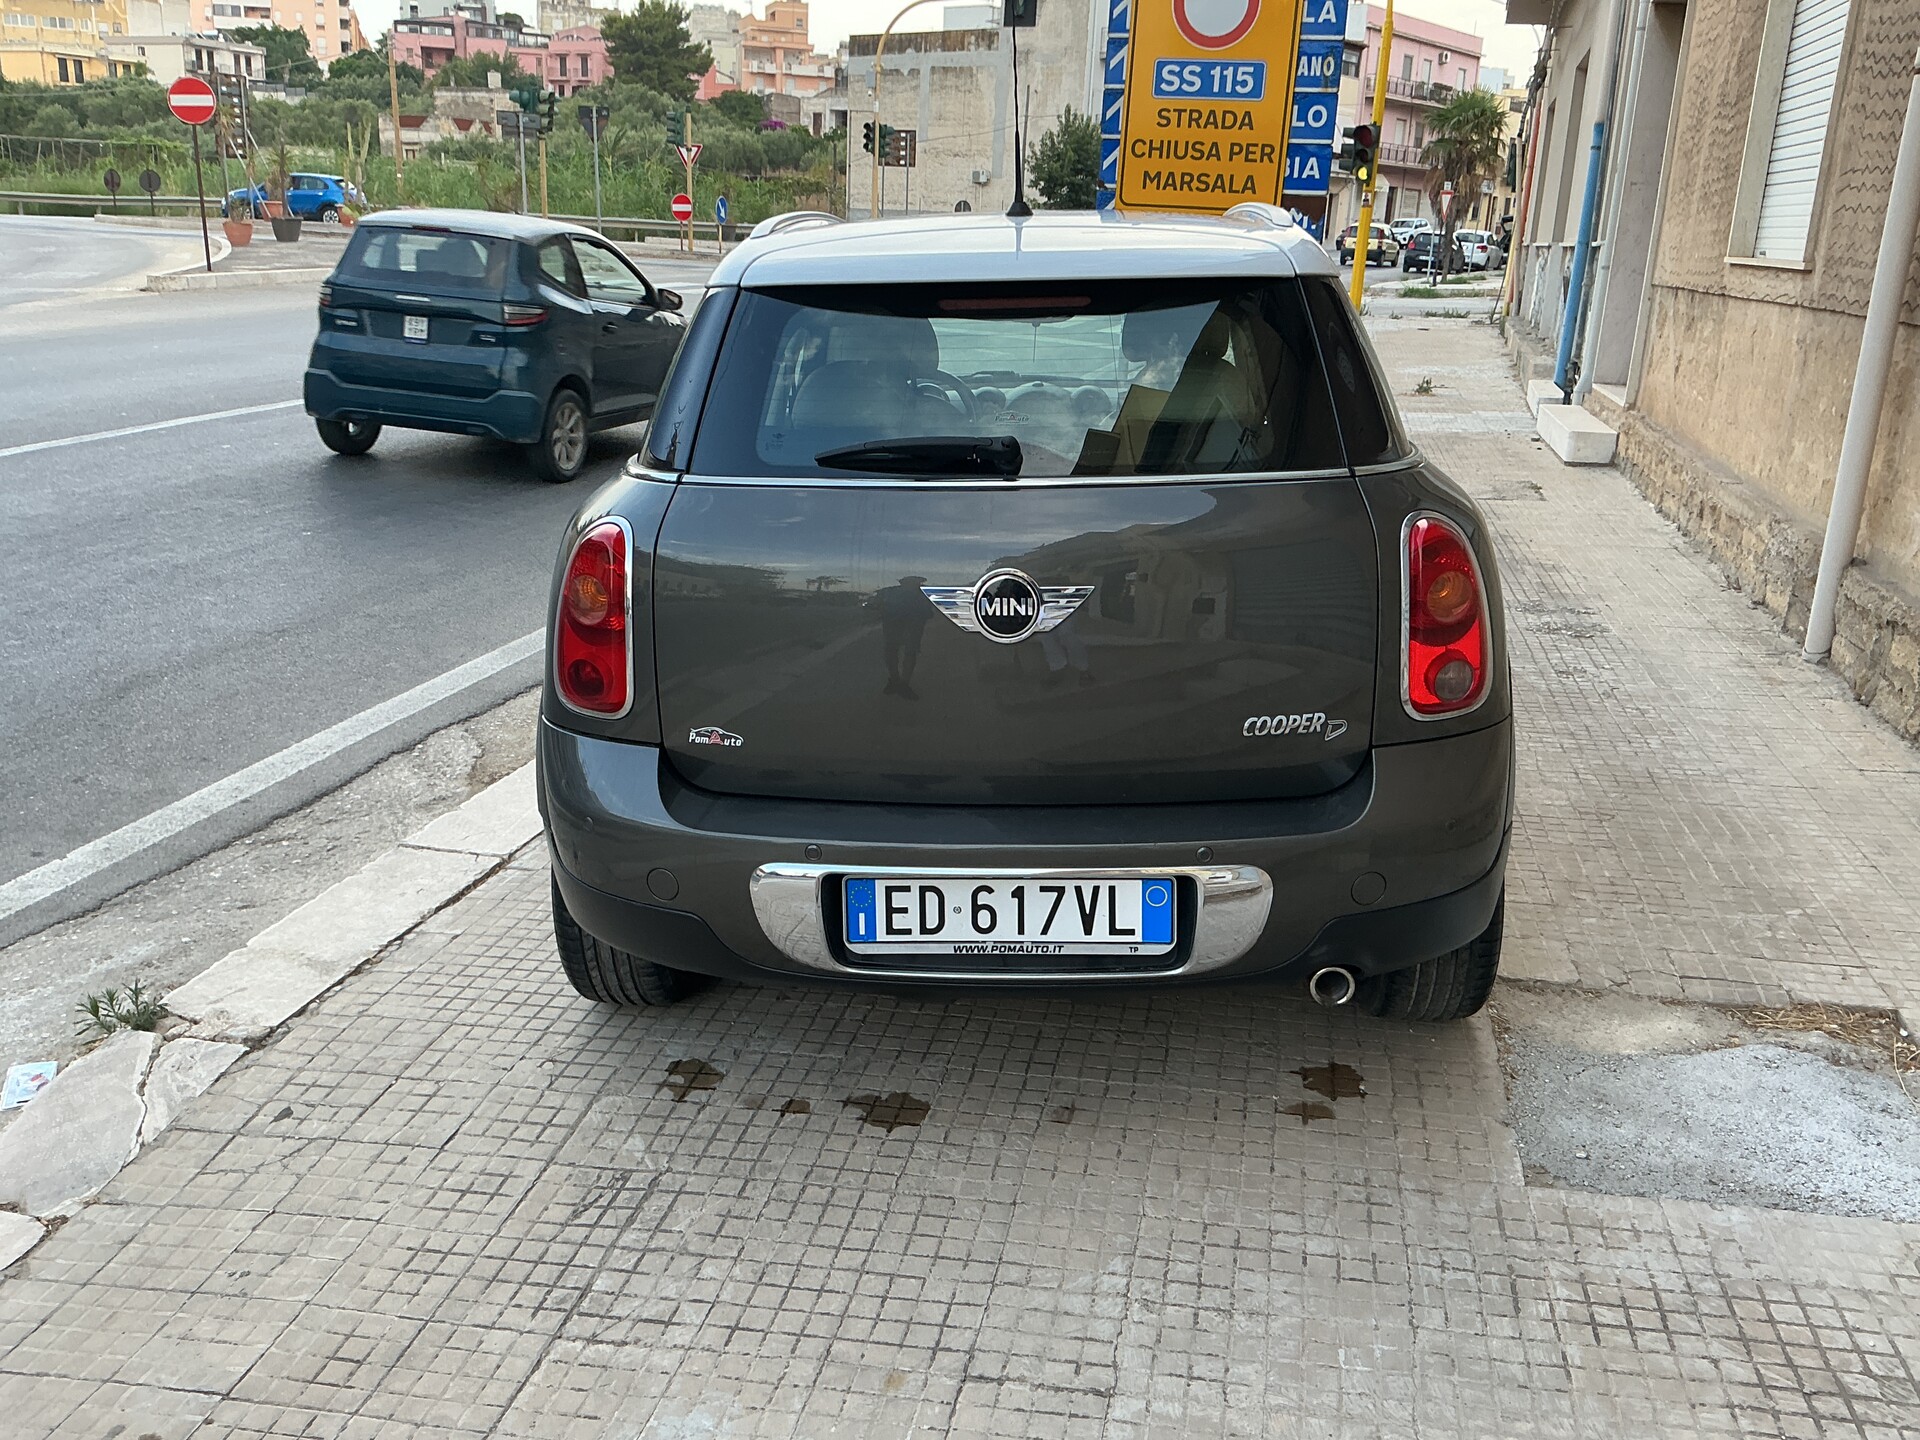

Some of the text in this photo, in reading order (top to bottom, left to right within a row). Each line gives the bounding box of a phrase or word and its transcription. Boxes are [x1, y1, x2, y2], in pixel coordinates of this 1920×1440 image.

[1160, 64, 1254, 94] SS 115
[1156, 108, 1254, 131] STRADA
[1131, 138, 1276, 164] CHIUSA PER
[1141, 170, 1257, 195] MARSALA
[980, 597, 1034, 617] MINI
[1242, 712, 1348, 741] COOPER D
[884, 885, 946, 936] ED
[953, 944, 1065, 954] WWW.POMAUTO.IT
